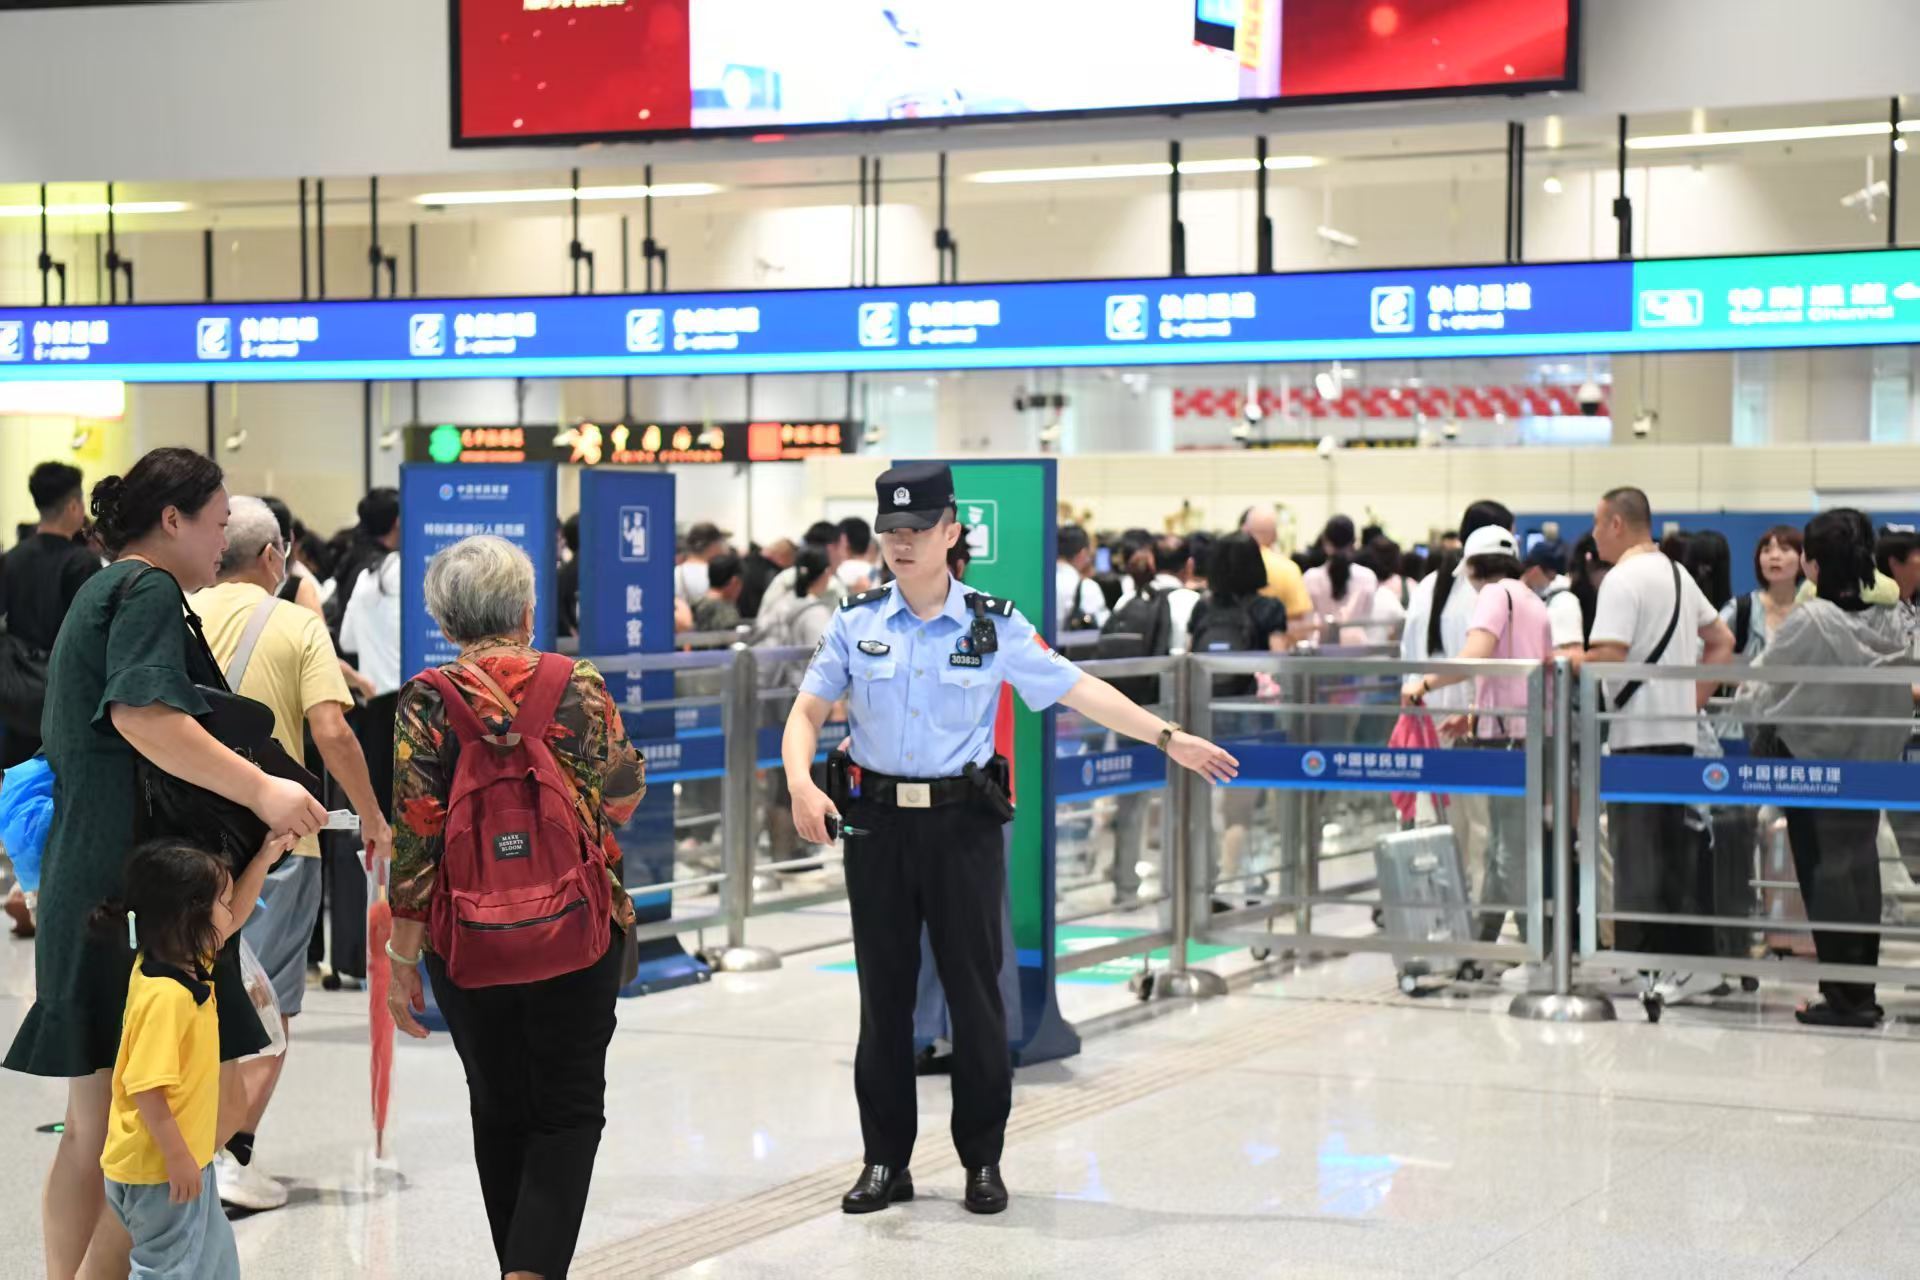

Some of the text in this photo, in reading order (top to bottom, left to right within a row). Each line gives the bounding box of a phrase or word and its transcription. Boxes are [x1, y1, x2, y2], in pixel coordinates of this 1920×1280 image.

[1738, 764, 1841, 783] 中国移民管理
[1742, 781, 1771, 792] CHINA
